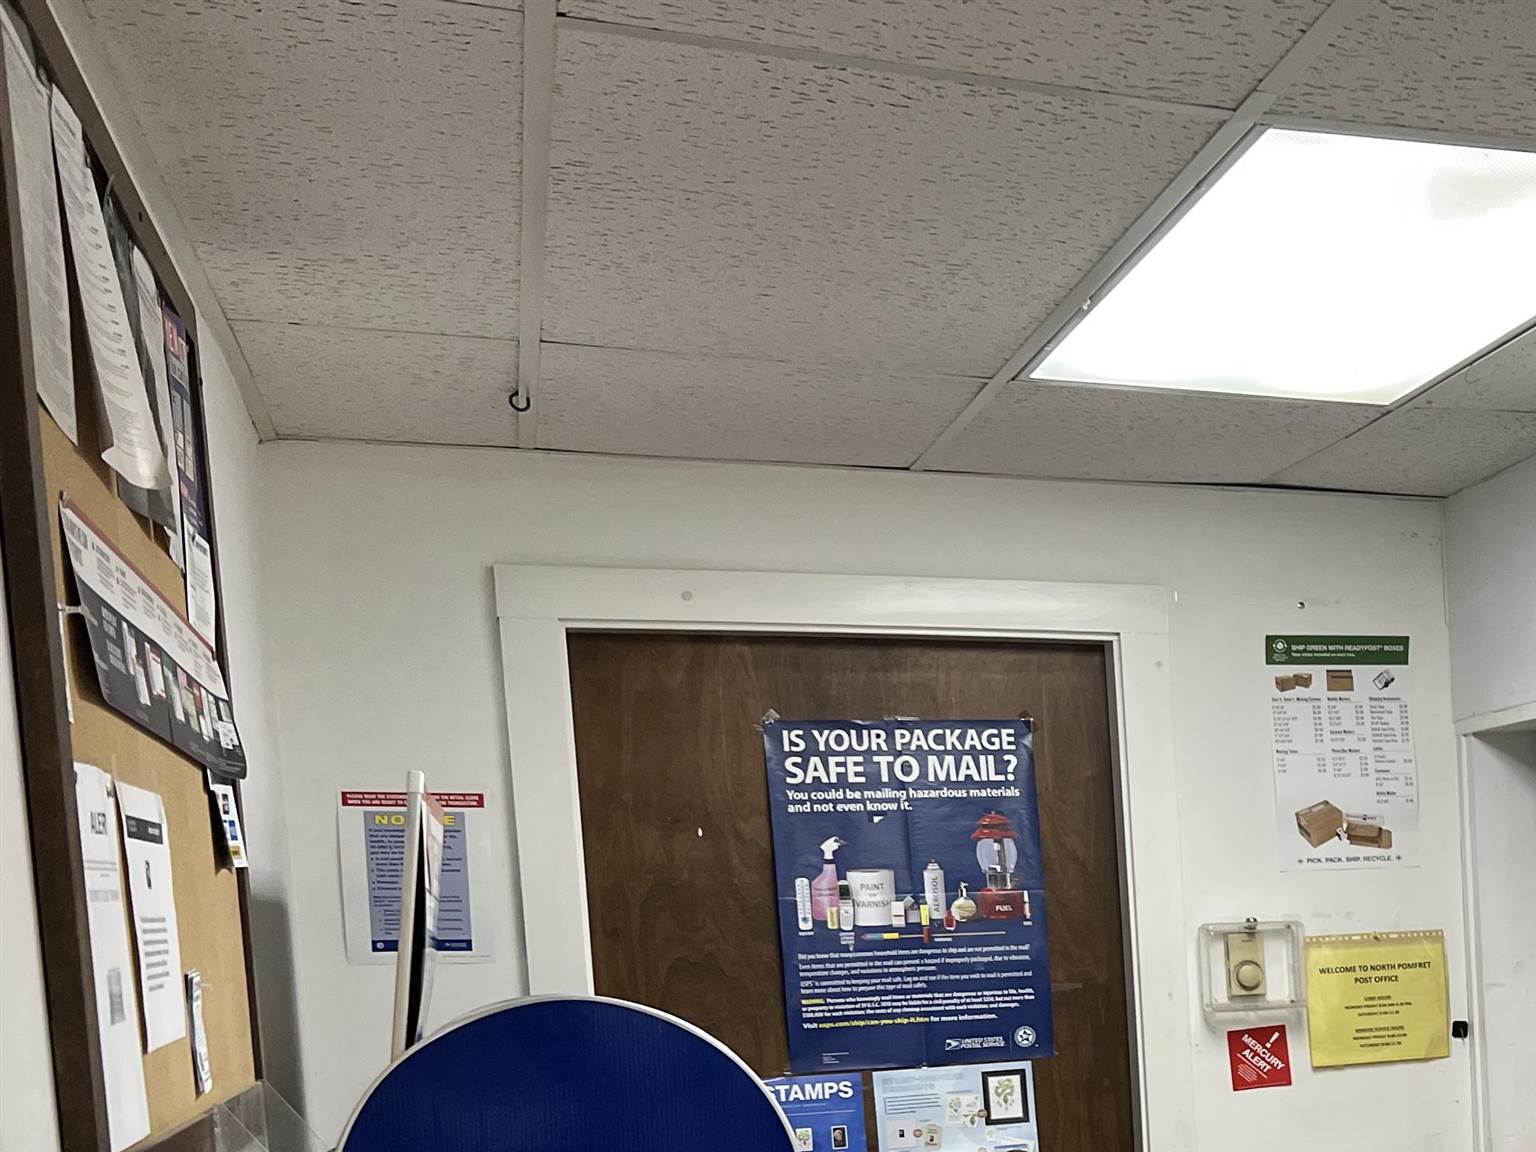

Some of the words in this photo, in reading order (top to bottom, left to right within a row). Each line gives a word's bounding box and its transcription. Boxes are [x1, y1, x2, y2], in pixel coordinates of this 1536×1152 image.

[782, 730, 807, 751] IS
[812, 730, 888, 751] YOUR
[894, 729, 1016, 750] PACKAGE
[785, 756, 866, 784] SAFE
[873, 756, 920, 782] TO
[928, 755, 1017, 782] MAIL?
[786, 790, 808, 800] You
[811, 789, 844, 799] could
[846, 789, 861, 799] be
[864, 788, 906, 802] mailing
[909, 788, 967, 798] hazardous
[970, 786, 1020, 797] materials
[787, 802, 811, 813] and
[814, 802, 833, 812] not
[837, 803, 864, 812] even
[867, 801, 897, 811] know
[901, 801, 913, 810] it.
[860, 883, 884, 892] PAINT
[1319, 965, 1357, 974] WELCOME
[1370, 963, 1396, 971] NORTH
[1398, 961, 1431, 969] POMFRET
[1242, 1034, 1284, 1070] MERCURY
[1242, 1049, 1271, 1073] ALERT
